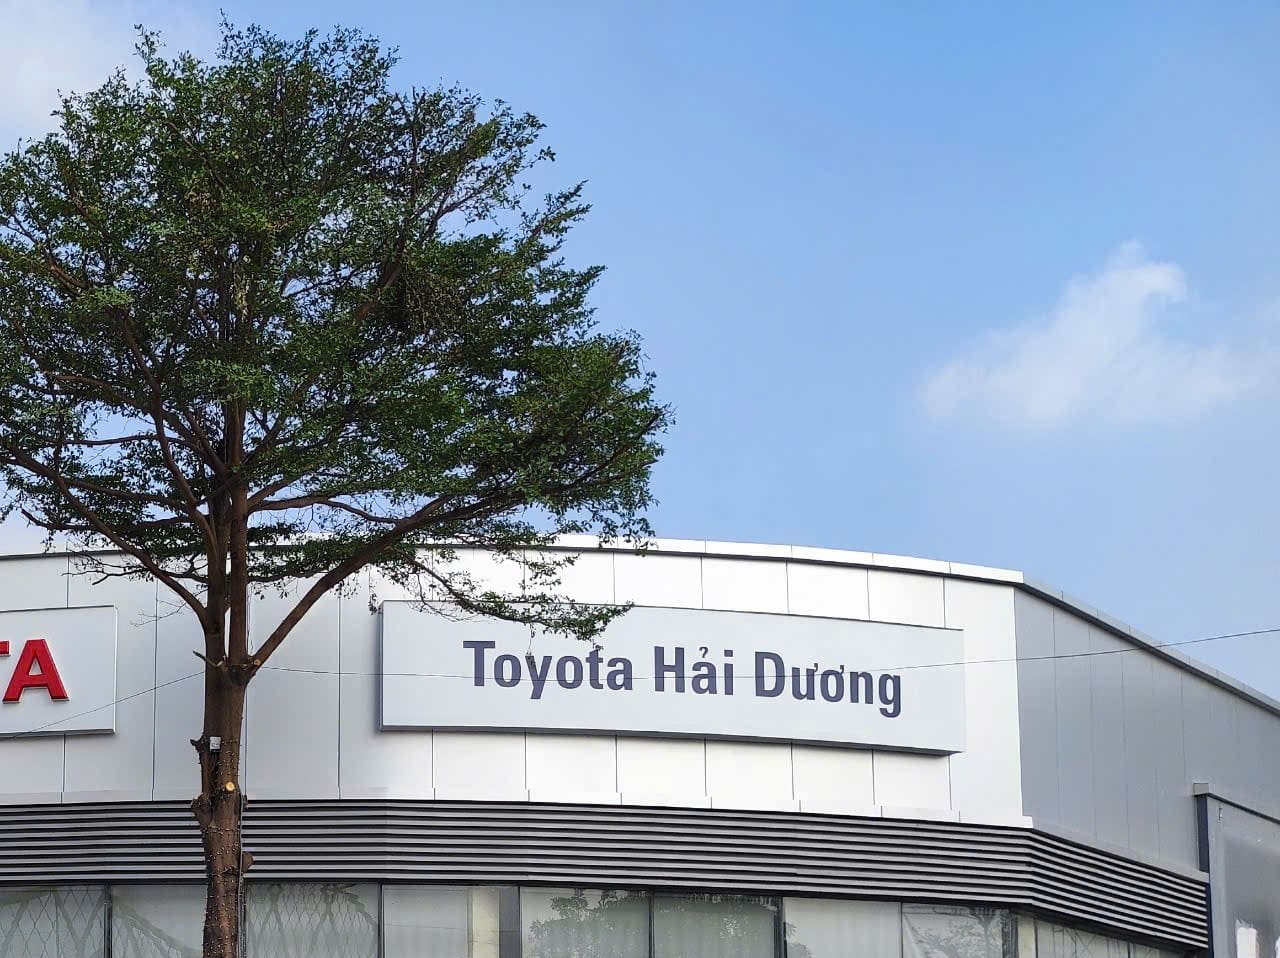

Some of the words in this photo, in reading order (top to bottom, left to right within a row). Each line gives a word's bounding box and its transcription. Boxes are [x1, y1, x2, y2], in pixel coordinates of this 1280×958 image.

[462, 640, 634, 701] Toyota
[654, 645, 735, 697] Hải
[753, 651, 902, 719] Dương
